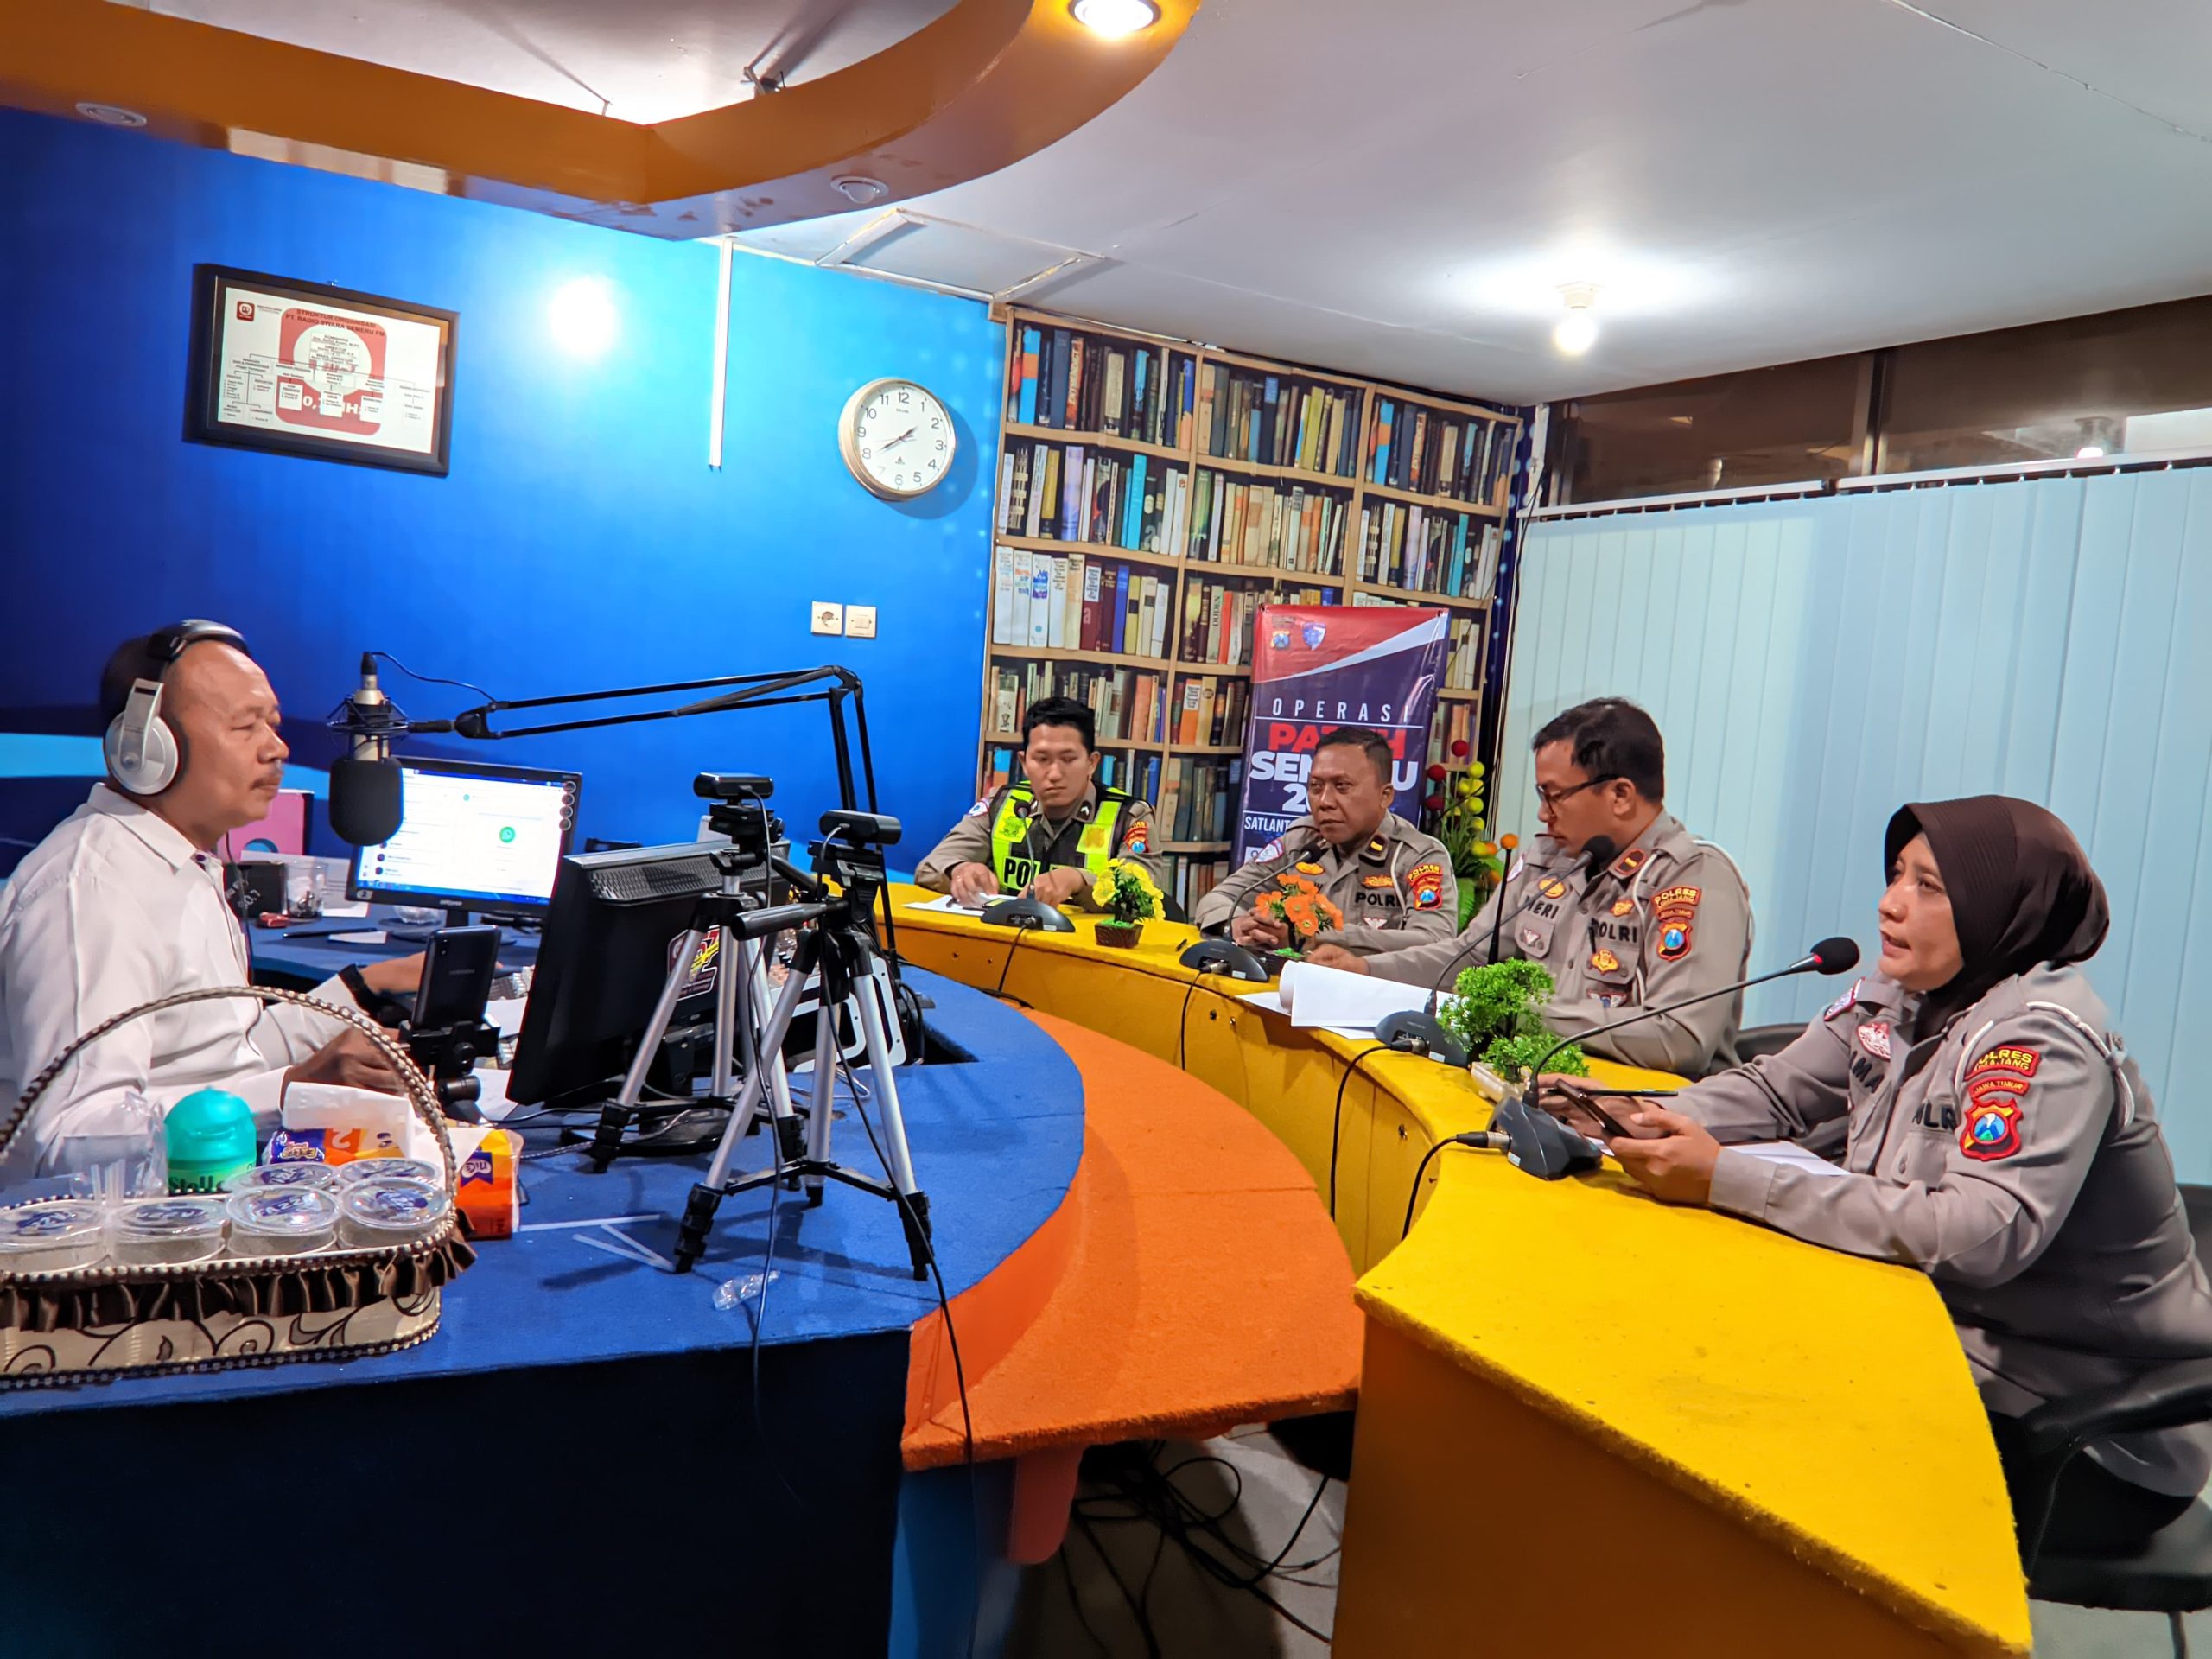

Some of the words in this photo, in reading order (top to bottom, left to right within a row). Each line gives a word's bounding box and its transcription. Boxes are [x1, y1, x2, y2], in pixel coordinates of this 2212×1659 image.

[297, 315, 319, 324] RADIO
[880, 394, 889, 405] 11
[898, 391, 910, 404] 12
[920, 401, 925, 412] 1
[865, 407, 877, 419] 10
[931, 417, 940, 429] 2
[857, 426, 867, 438] 9
[934, 440, 944, 451] 3
[861, 448, 871, 460] 8
[927, 459, 937, 469] 4
[877, 466, 887, 475] 7
[894, 474, 904, 486] 6
[912, 471, 922, 483] 5
[1272, 697, 1409, 723] OPERASI
[1268, 722, 1407, 760] PAH
[1243, 815, 1291, 833] SATLANT
